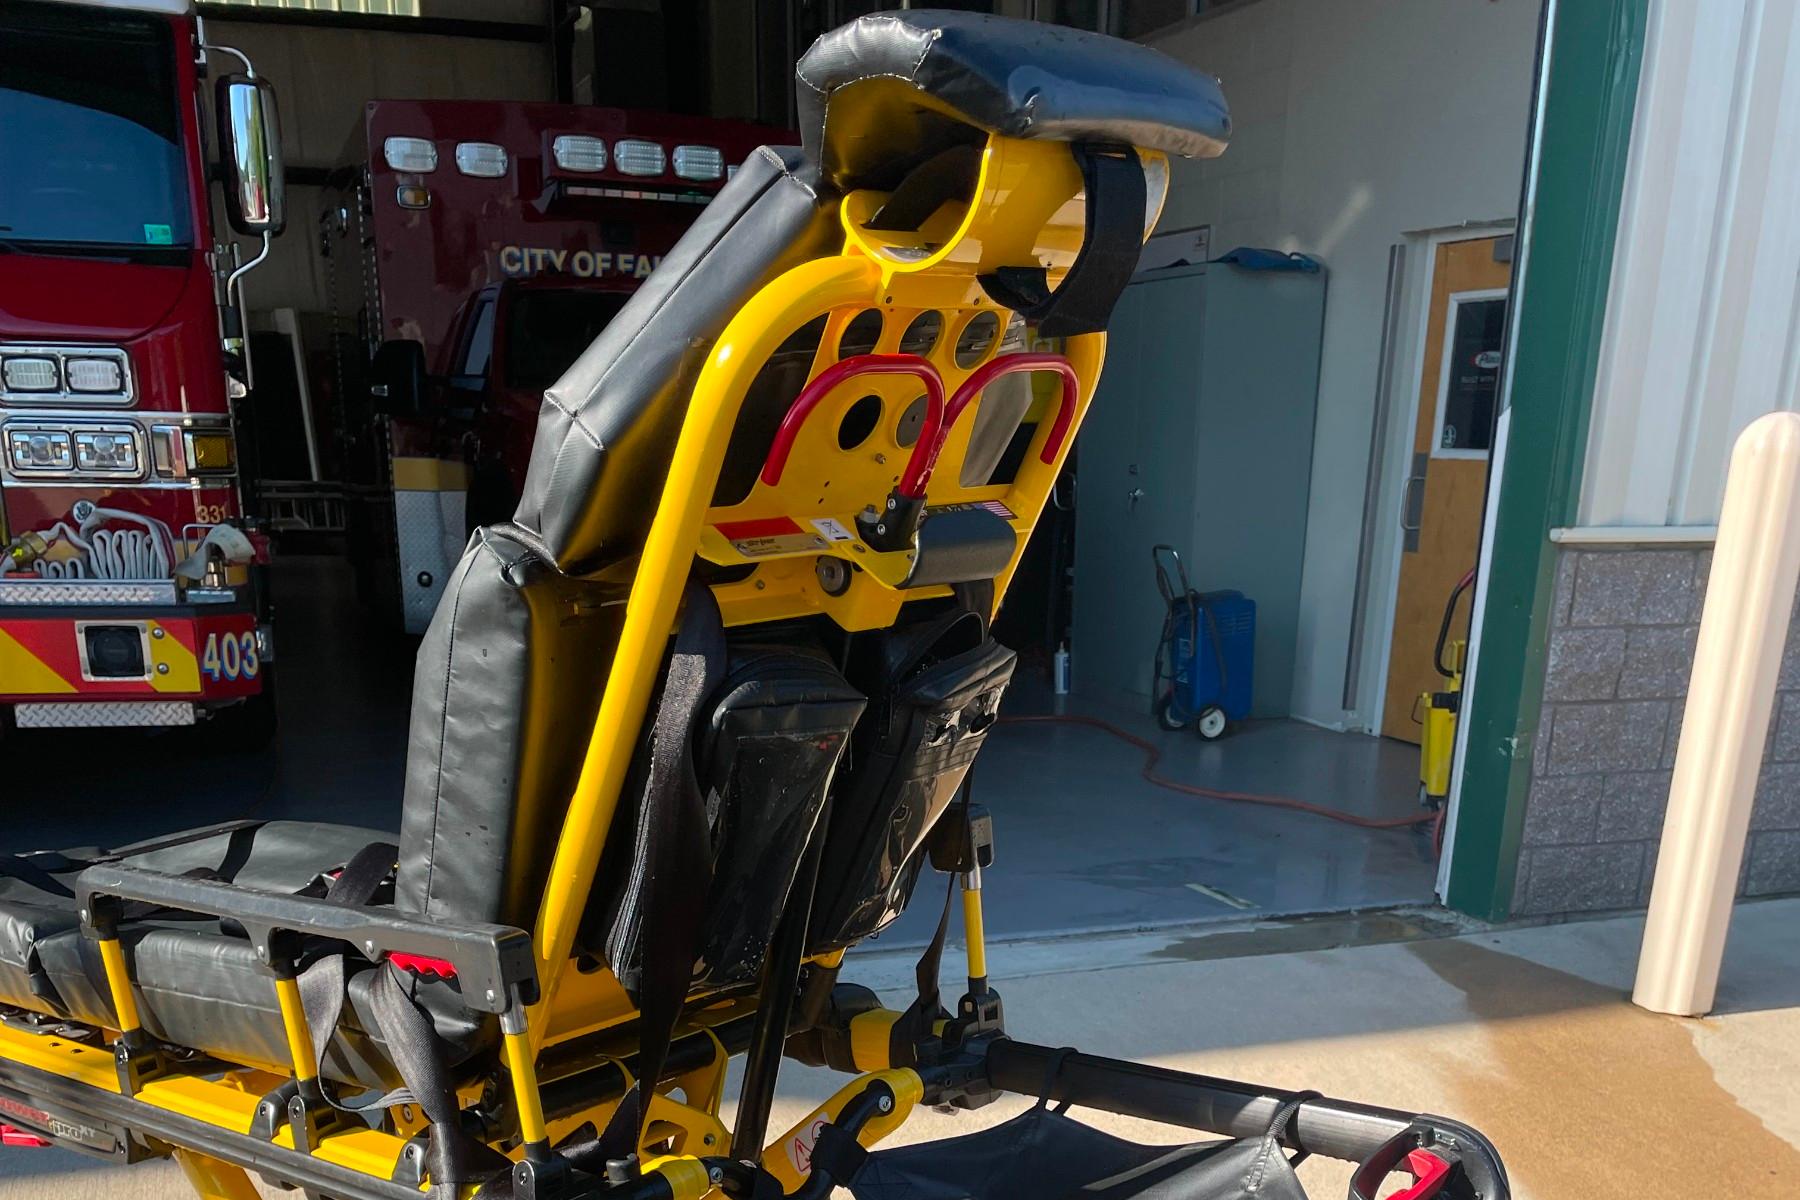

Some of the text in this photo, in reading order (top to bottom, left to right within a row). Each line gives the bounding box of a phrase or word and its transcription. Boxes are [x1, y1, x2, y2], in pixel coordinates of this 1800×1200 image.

[501, 246, 567, 274] CITY
[572, 250, 611, 277] OF
[202, 631, 259, 681] 403
